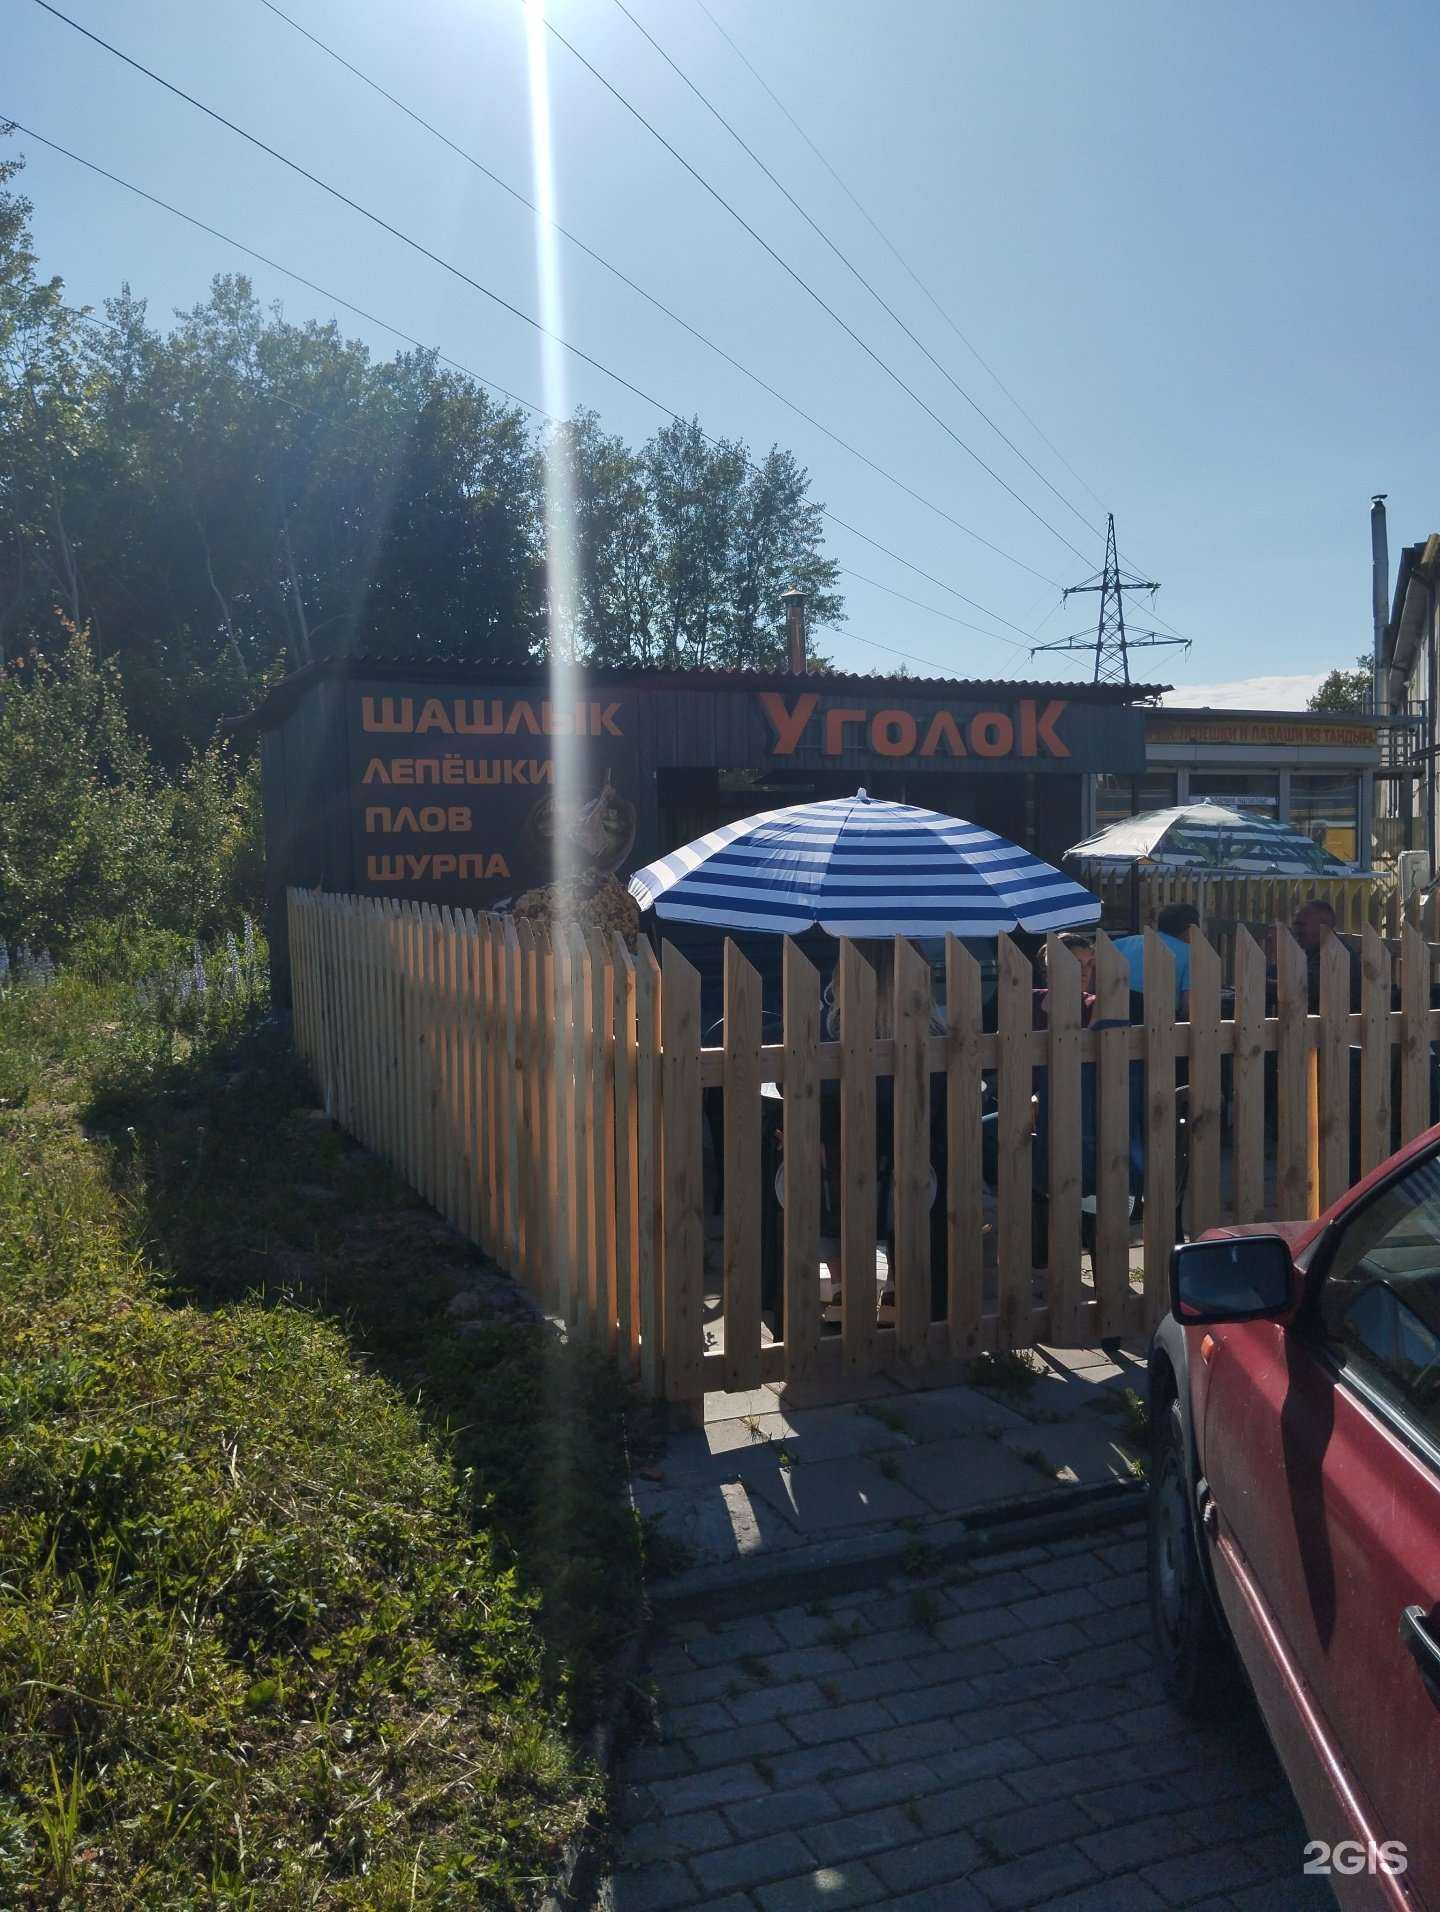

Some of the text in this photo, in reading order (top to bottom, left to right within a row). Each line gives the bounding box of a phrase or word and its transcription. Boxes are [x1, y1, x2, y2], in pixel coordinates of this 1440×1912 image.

[361, 696, 624, 736] ШАШЛЫК
[361, 753, 557, 784] ЛЕПЁШКИ
[365, 806, 473, 832] ПЛОВ
[367, 853, 511, 880] ШУРПА
